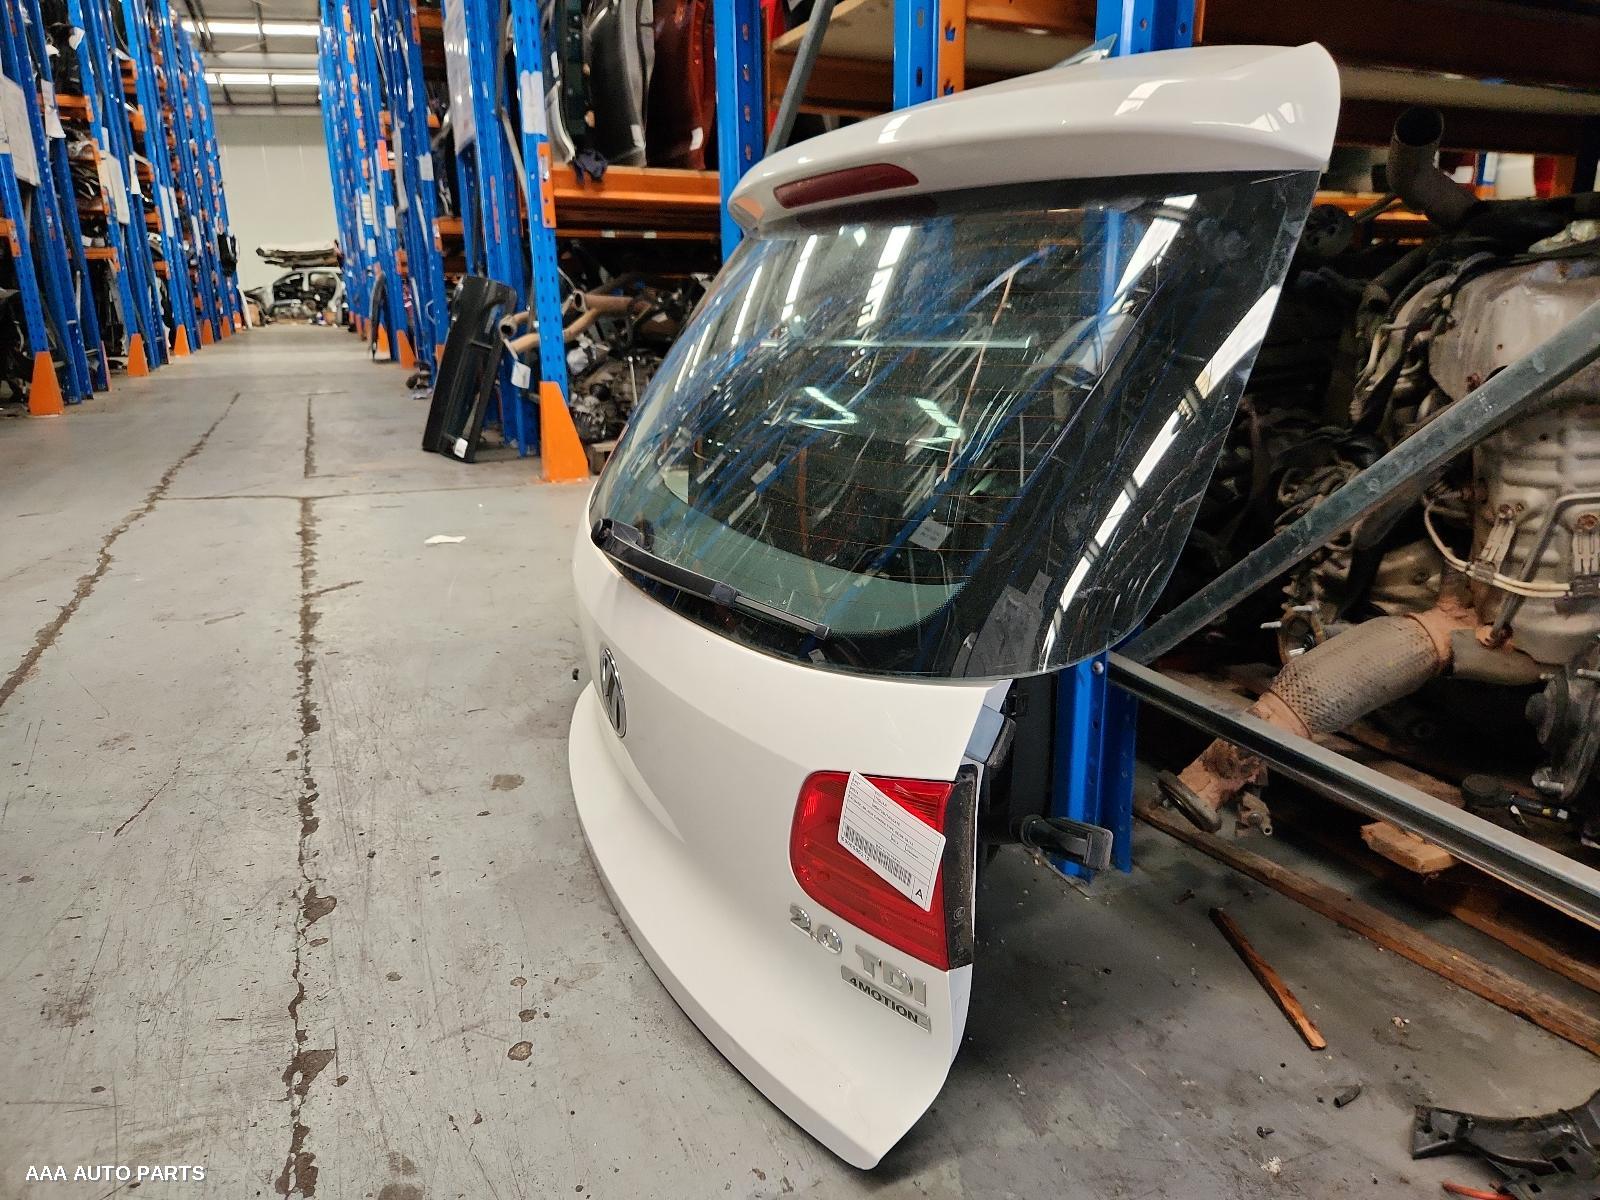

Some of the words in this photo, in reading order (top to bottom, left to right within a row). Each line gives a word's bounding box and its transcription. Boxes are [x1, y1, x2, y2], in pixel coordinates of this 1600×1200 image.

[915, 888, 924, 900] A
[789, 903, 843, 954] 2.0
[855, 944, 927, 1007] TDI
[849, 977, 919, 1024] 4MOTION
